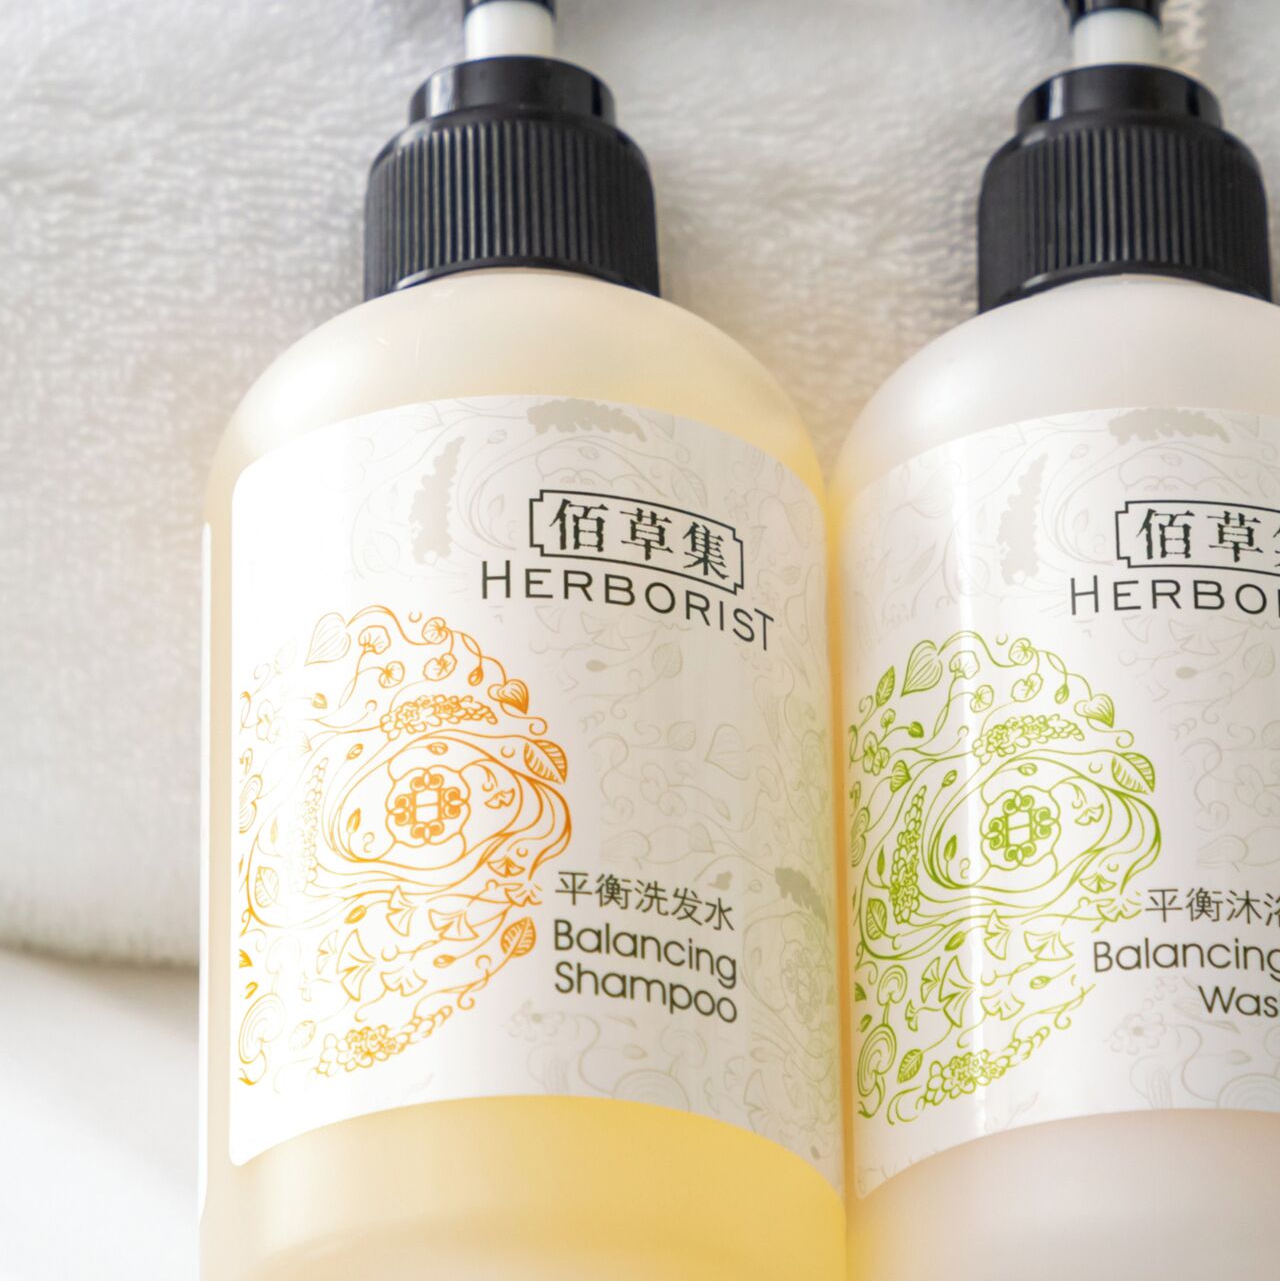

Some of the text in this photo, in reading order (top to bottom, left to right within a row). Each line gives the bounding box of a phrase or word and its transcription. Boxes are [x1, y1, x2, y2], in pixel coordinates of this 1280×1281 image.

[549, 498, 731, 580] 佰草集
[482, 559, 775, 651] HERBORIST
[554, 869, 734, 932] 平衡洗发水
[553, 918, 737, 988] Balancing
[554, 961, 737, 1024] Shampoo
